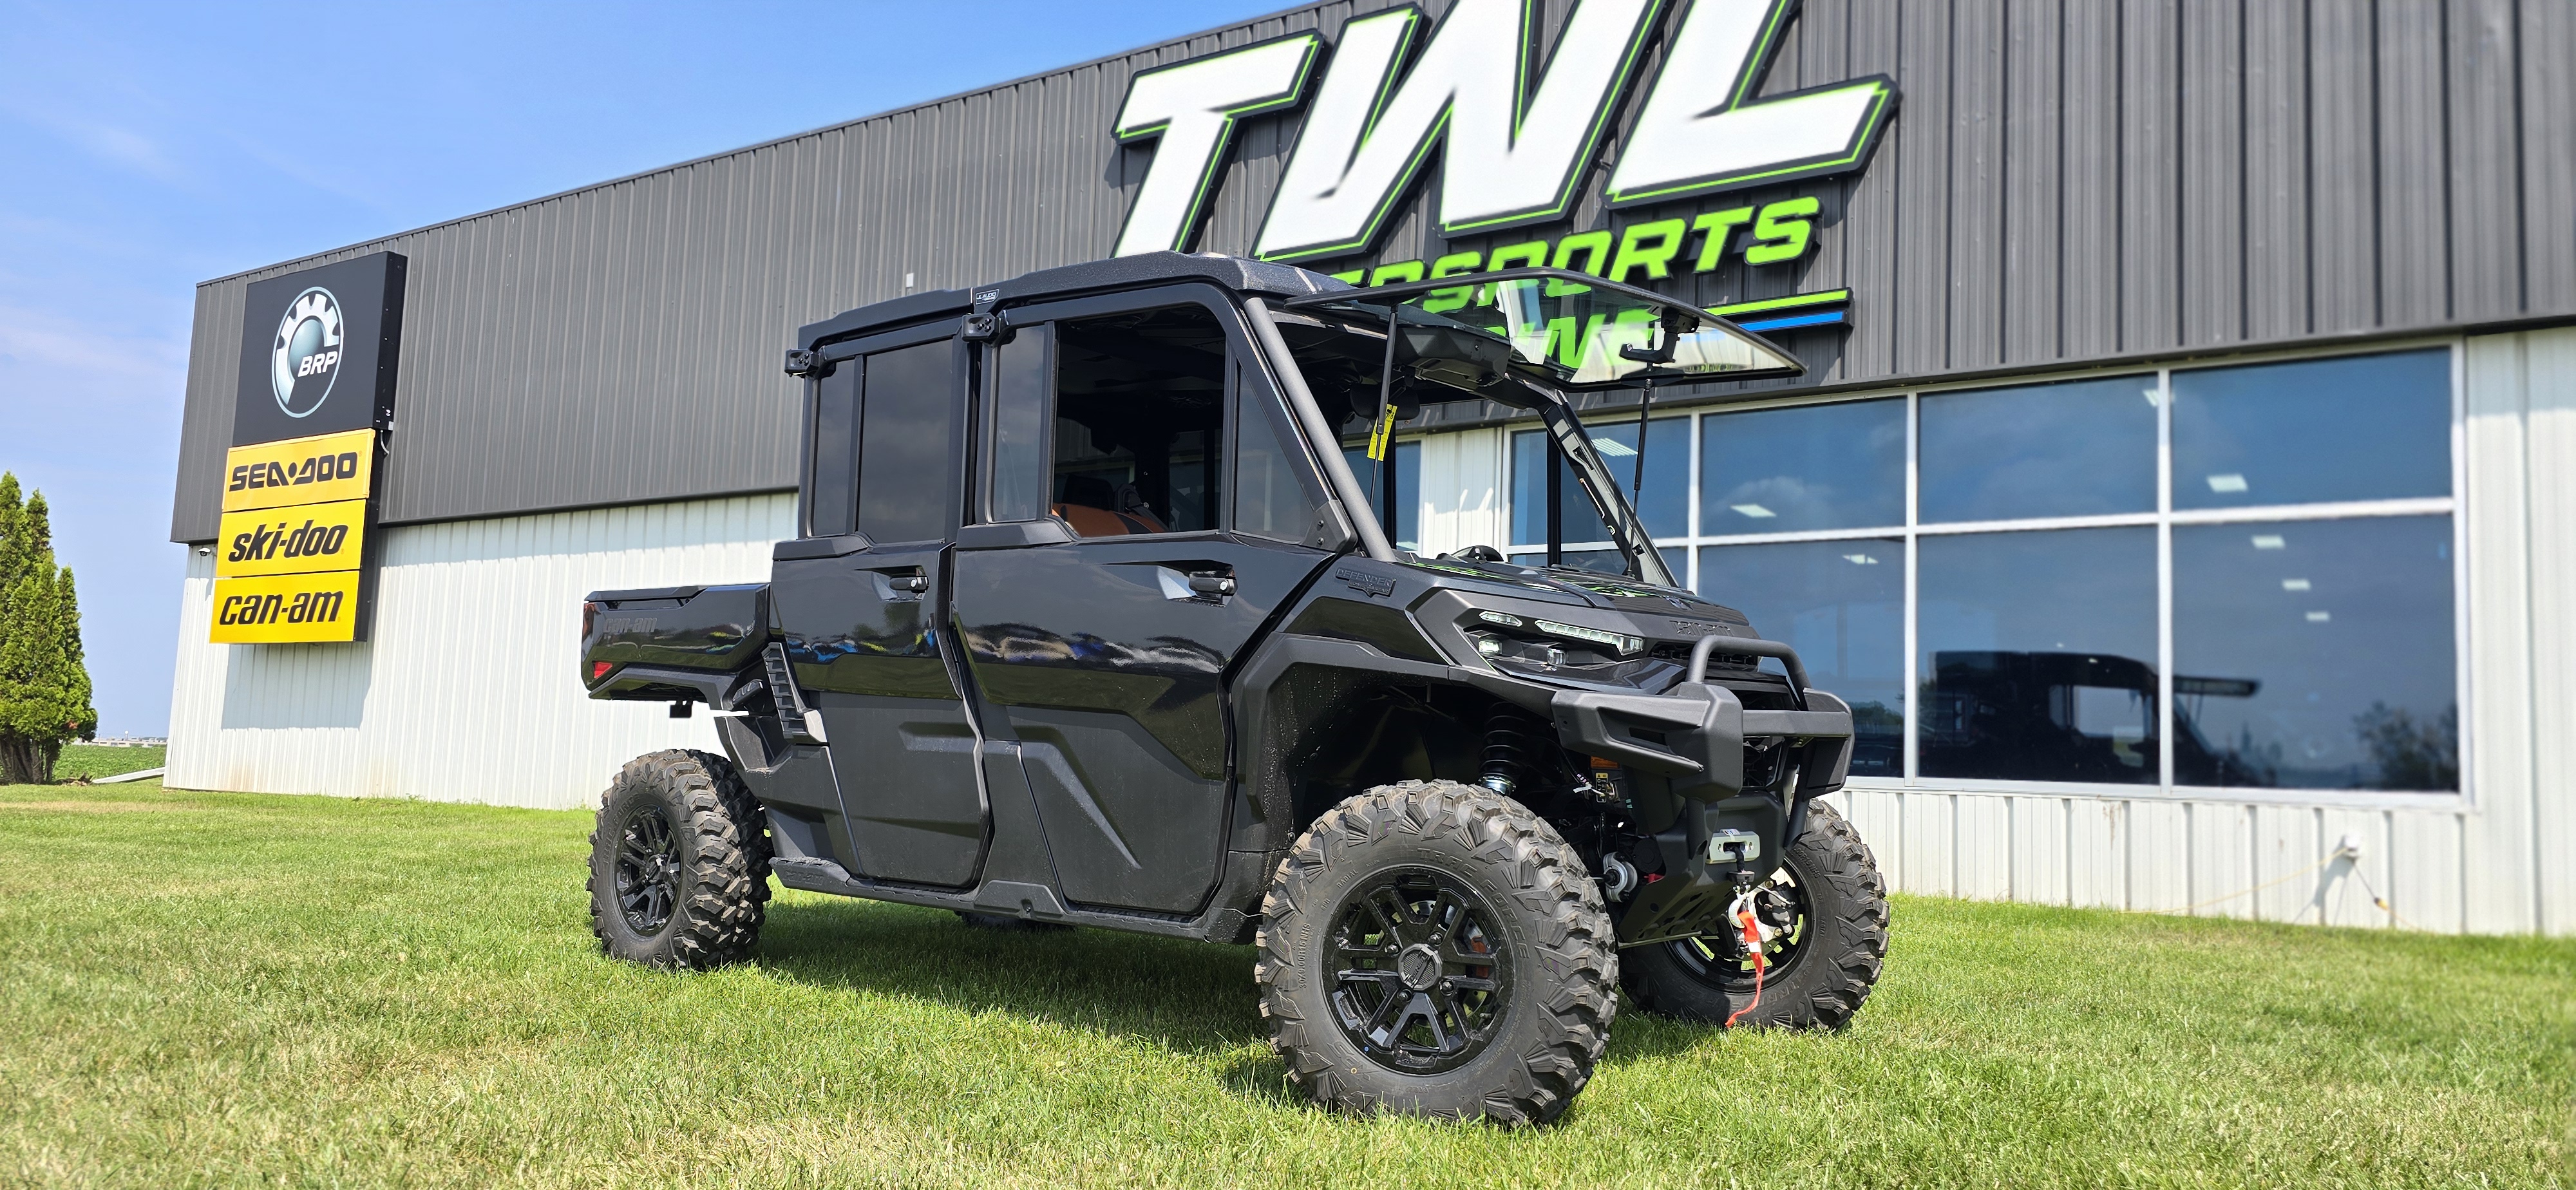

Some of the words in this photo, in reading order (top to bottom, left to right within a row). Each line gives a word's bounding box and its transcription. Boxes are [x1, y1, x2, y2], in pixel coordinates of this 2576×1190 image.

[1114, 0, 1892, 263] TWL
[298, 351, 338, 377] BRP
[228, 520, 348, 562] ski-doo
[1336, 568, 1392, 587] DEFENDER
[219, 590, 344, 625] can-am
[603, 618, 657, 633] can-am
[1336, 869, 1359, 889] RADIAL
[1417, 847, 1477, 878] TRAC
[1480, 879, 1530, 959] FORCE
